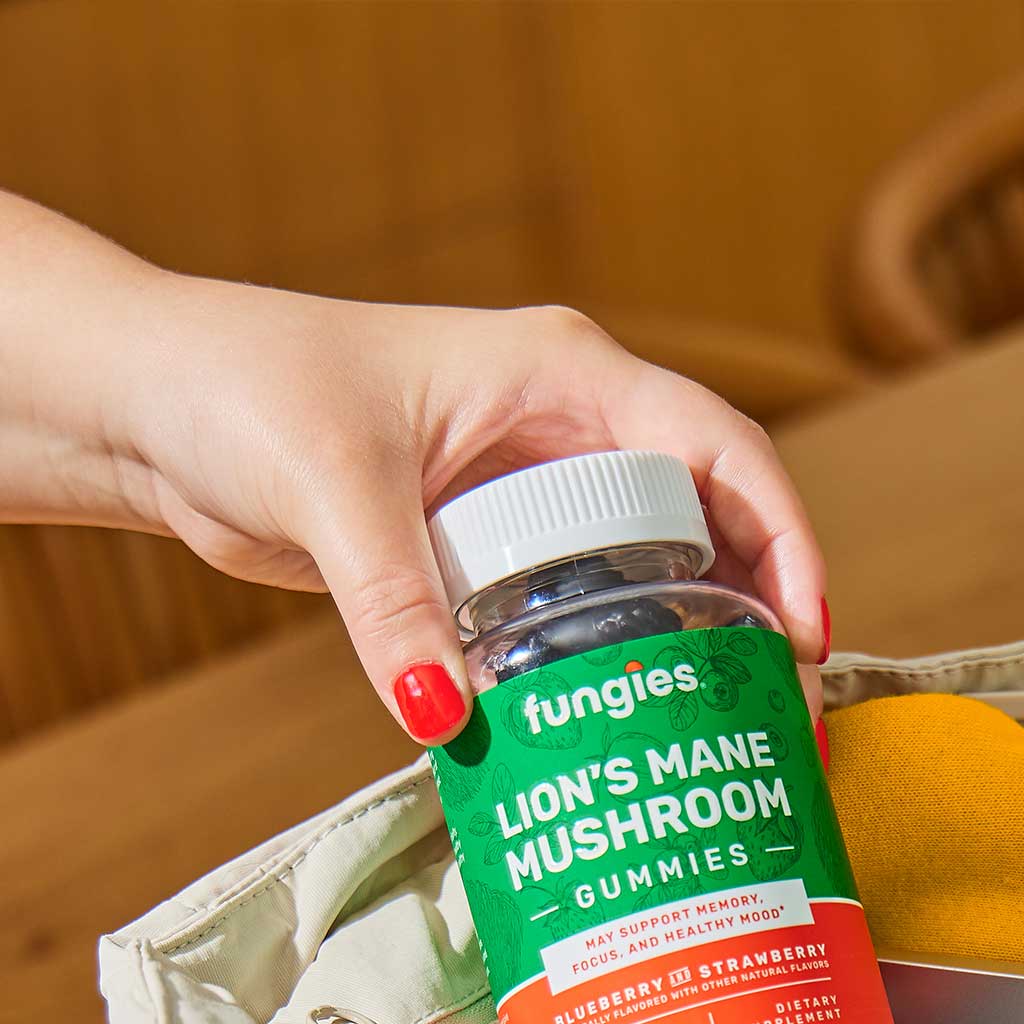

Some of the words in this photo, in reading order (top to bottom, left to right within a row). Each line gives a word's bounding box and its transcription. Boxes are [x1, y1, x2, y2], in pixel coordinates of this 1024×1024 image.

[524, 660, 699, 734] fungies
[495, 756, 638, 839] LION'S
[646, 733, 775, 784] MANE
[506, 778, 792, 891] MUSHROOM
[576, 843, 748, 908] GUMMIES
[573, 950, 624, 974] FOCUS,
[629, 937, 659, 953] AND
[666, 918, 734, 942] HEALTHY
[586, 933, 614, 950] MAY
[620, 909, 689, 938] SUPPORT
[697, 894, 763, 914] MEMORY,
[615, 995, 667, 1020] FLAVORED
[671, 986, 698, 1001] WITH
[702, 976, 738, 992] OTHER
[741, 966, 787, 983] NATURAL
[791, 960, 829, 973] FLAVORS
[670, 967, 691, 987] AND
[700, 944, 828, 979] STRAWBERRY
[776, 995, 838, 1014] DIETARY
